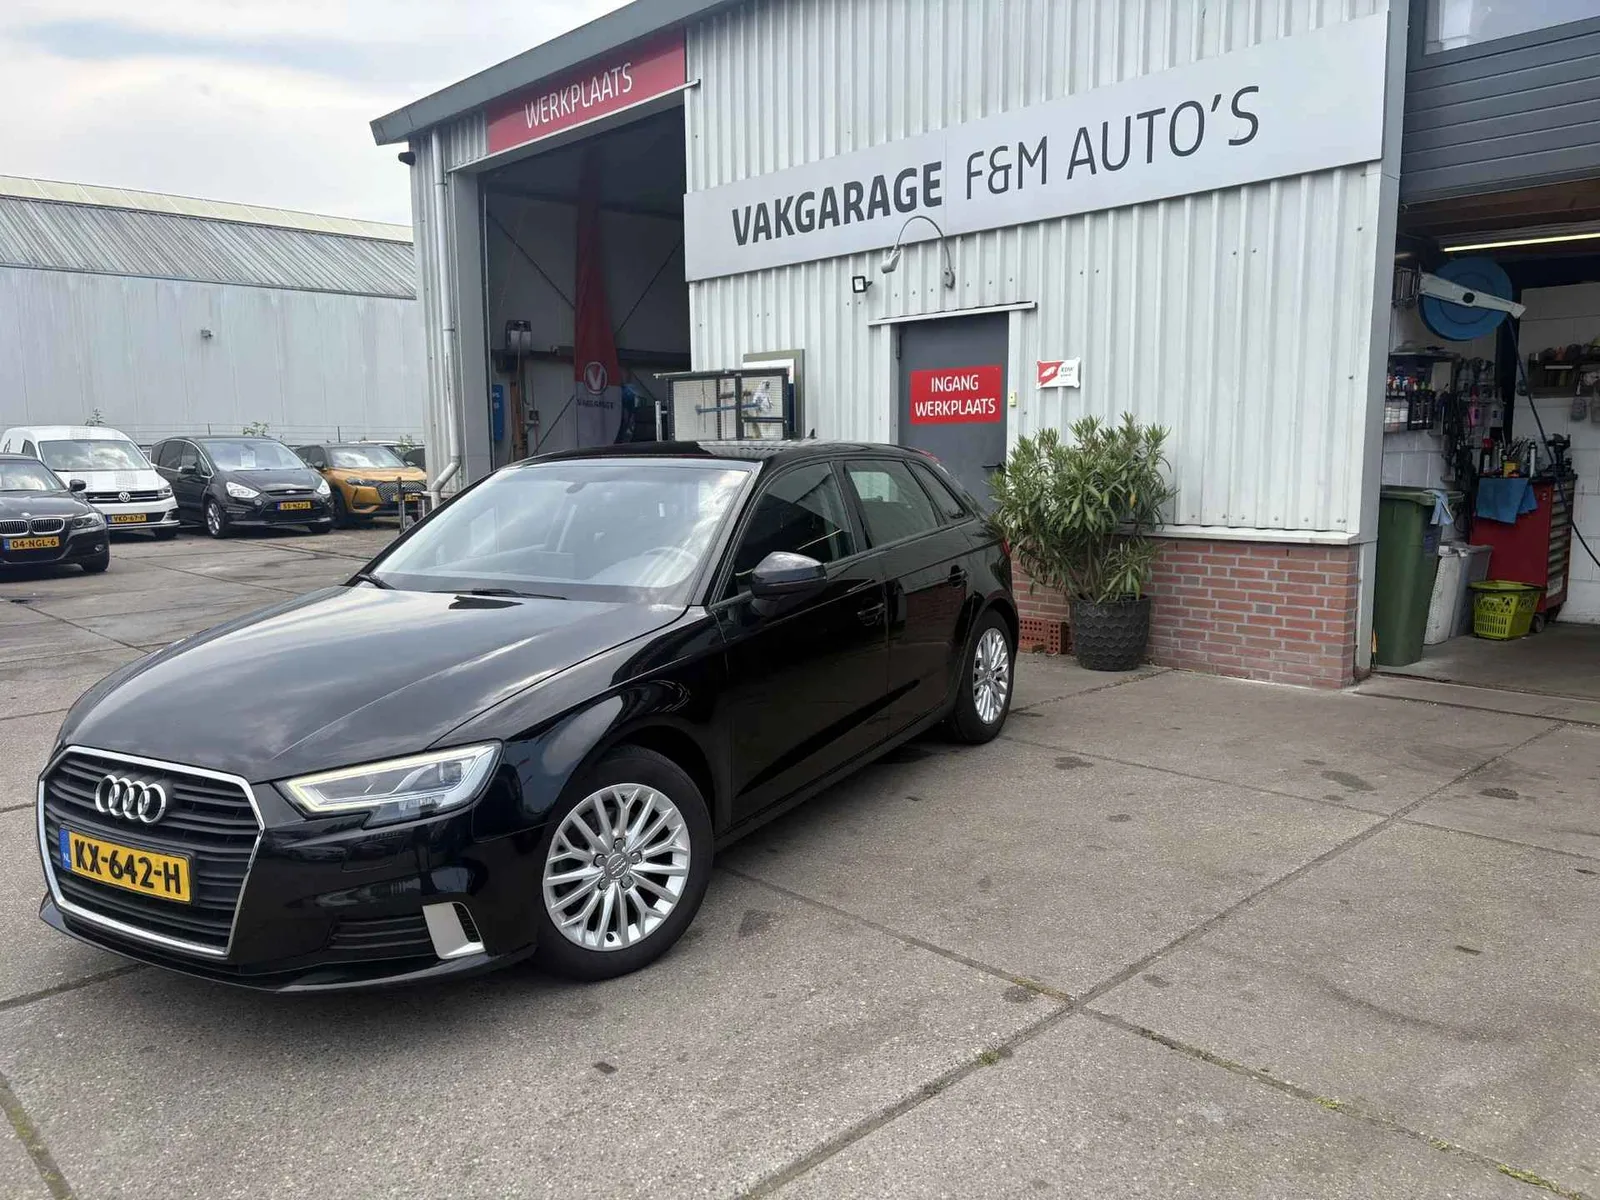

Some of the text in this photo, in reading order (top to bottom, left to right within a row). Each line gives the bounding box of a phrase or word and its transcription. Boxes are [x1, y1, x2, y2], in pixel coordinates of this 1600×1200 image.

[525, 62, 633, 129] WERKPLAATS
[732, 86, 1259, 246] VAKGARAGE F&M AUTO'S
[931, 374, 979, 393] INGANG
[915, 398, 996, 417] WERKPLAATS
[12, 538, 56, 549] 04-NGL-6
[74, 838, 181, 895] KX-642-H
